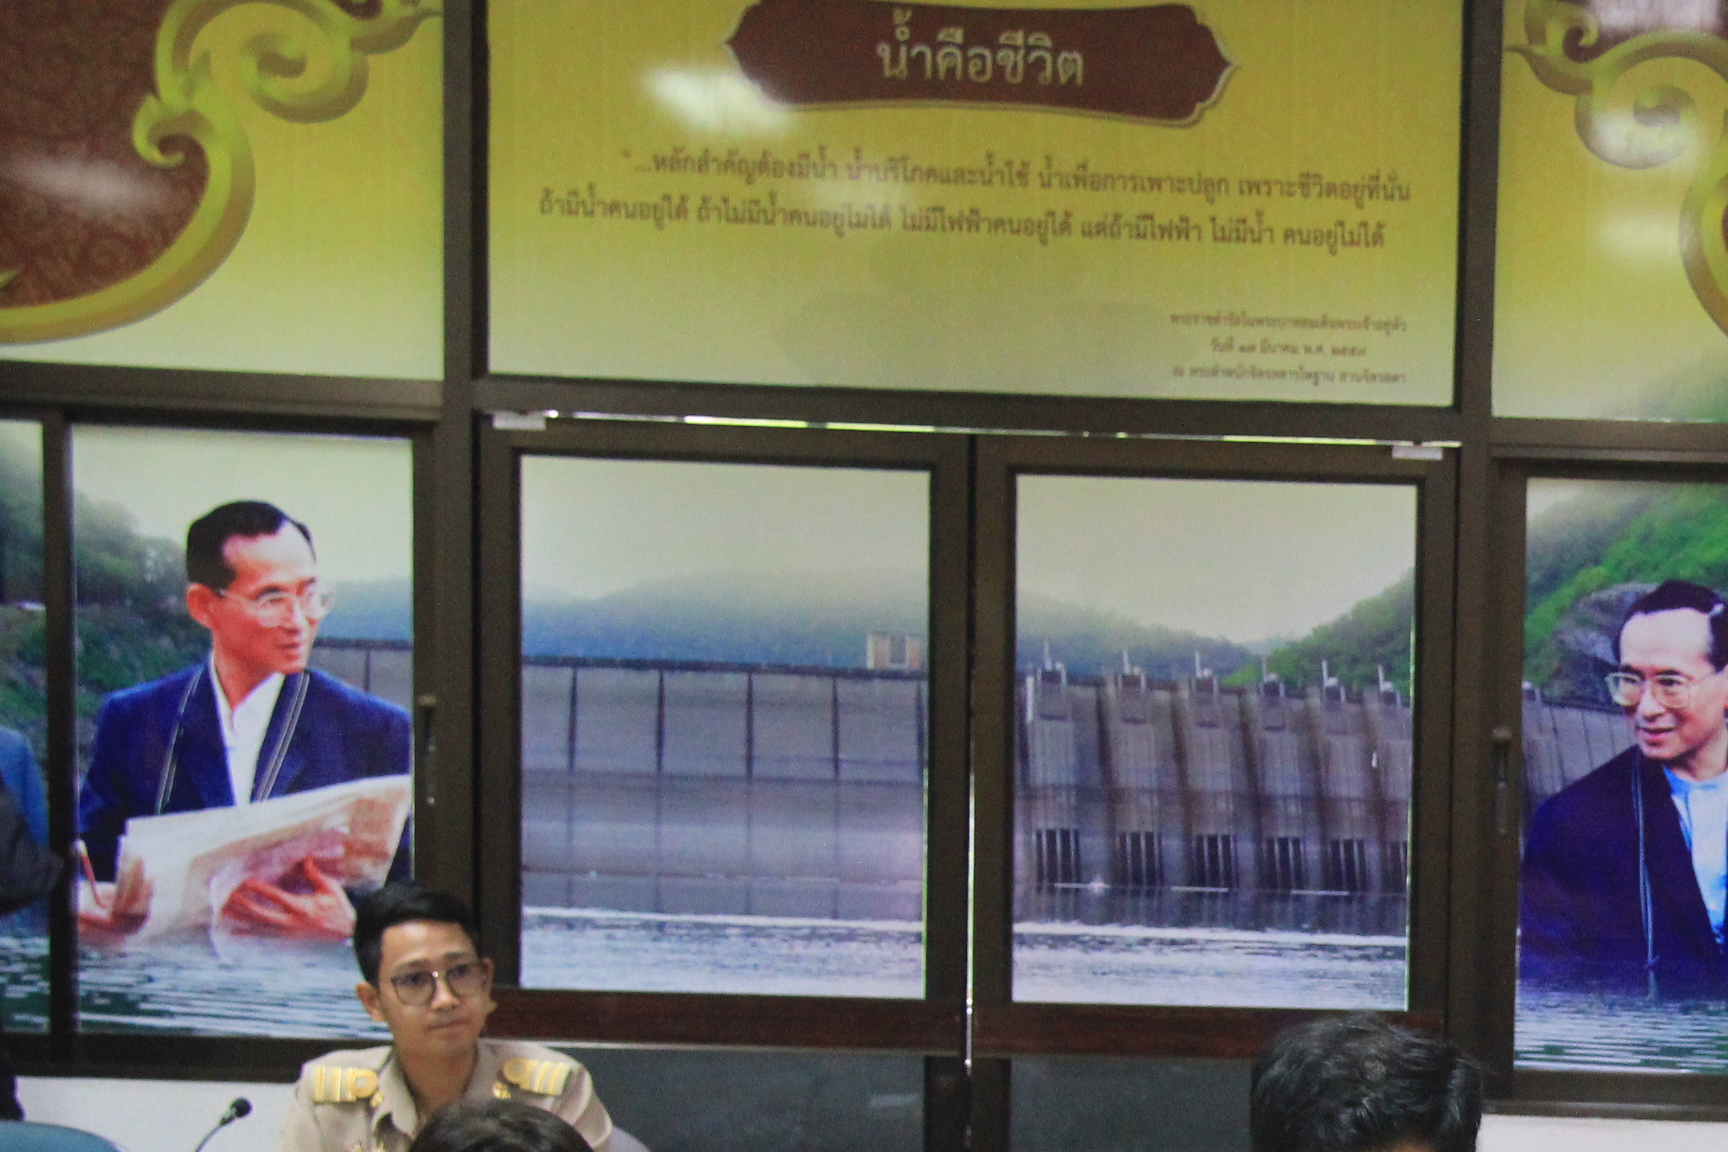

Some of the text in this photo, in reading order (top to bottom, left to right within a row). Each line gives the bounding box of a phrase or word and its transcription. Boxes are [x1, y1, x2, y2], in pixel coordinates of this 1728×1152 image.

[876, 8, 1085, 86] น้ำคือชีวิต
